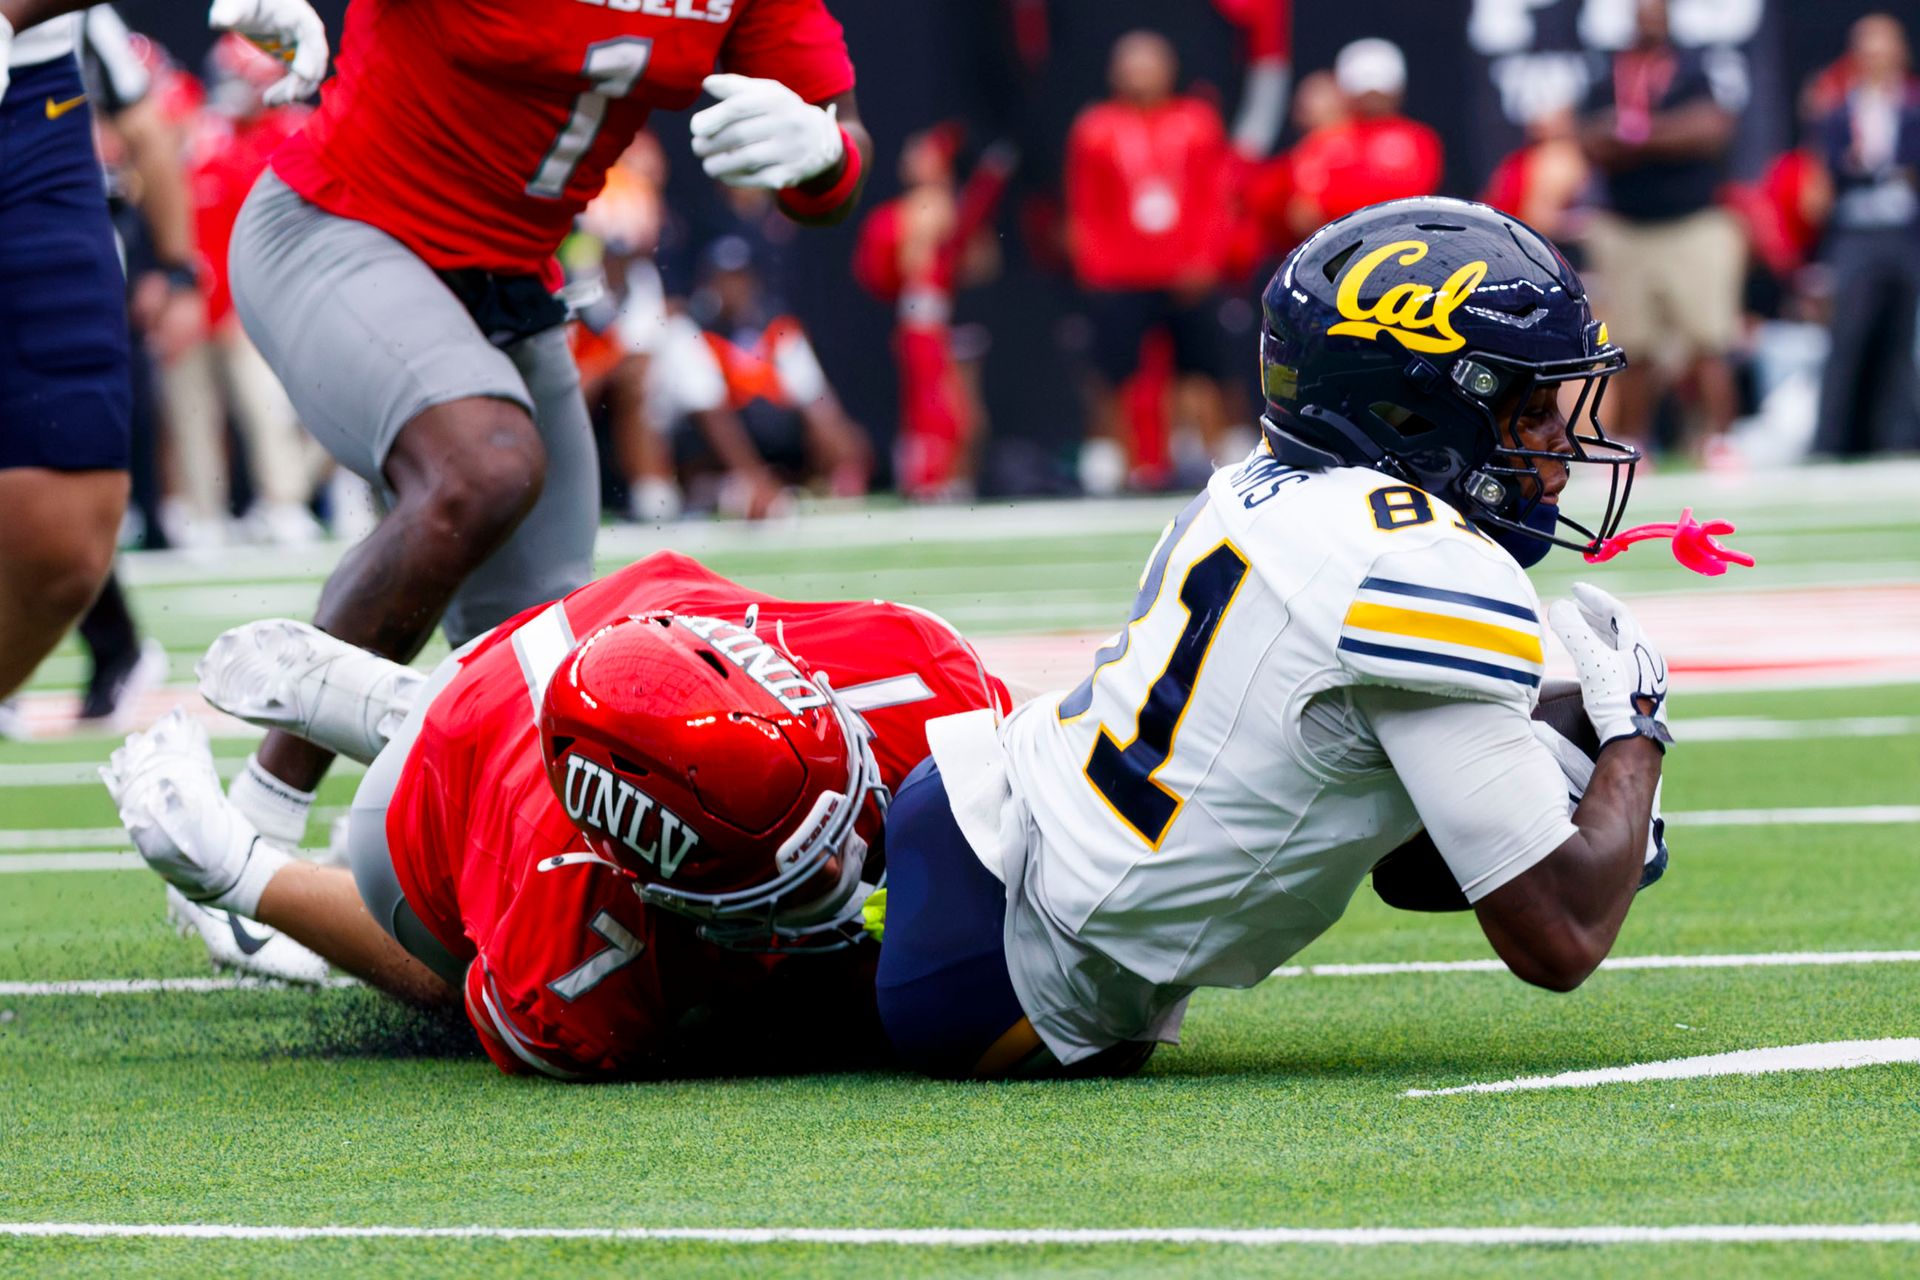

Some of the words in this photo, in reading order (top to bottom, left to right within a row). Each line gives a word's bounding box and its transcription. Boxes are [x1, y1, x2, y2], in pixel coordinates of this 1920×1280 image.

[1327, 240, 1488, 354] Cal
[564, 750, 701, 881] UNLV
[546, 907, 646, 1001] 7
